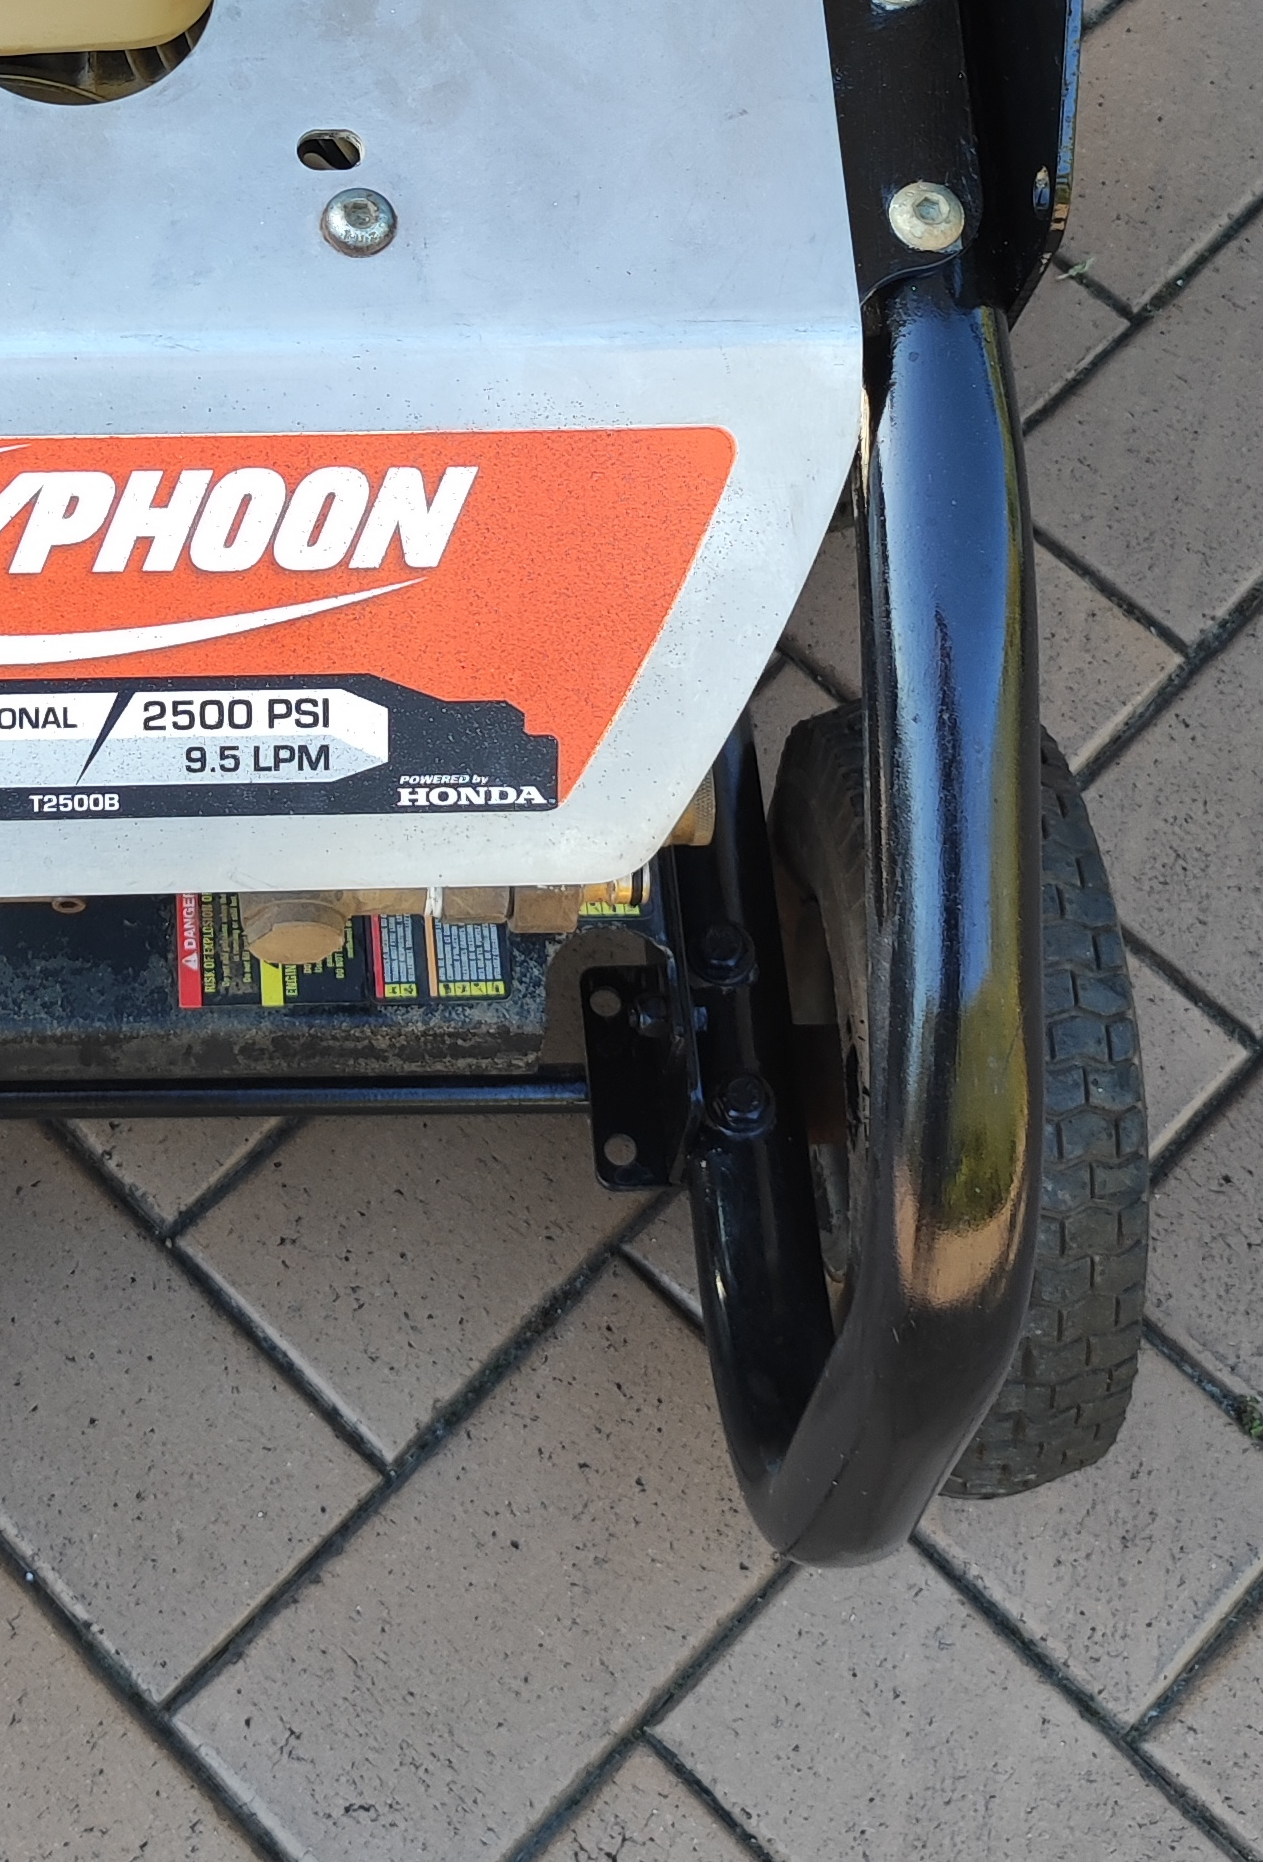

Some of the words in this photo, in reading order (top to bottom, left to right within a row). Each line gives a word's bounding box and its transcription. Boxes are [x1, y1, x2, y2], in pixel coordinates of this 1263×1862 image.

[143, 700, 252, 731] 2500
[268, 698, 330, 729] PSI
[184, 745, 241, 774] 9.5
[253, 744, 330, 772] LPM
[399, 774, 469, 785] POWERED
[472, 774, 489, 785] by
[28, 794, 119, 813] T2500B
[396, 786, 547, 806] HONDA
[201, 904, 214, 955] EXPLOSION
[285, 964, 299, 996] ENGIN
